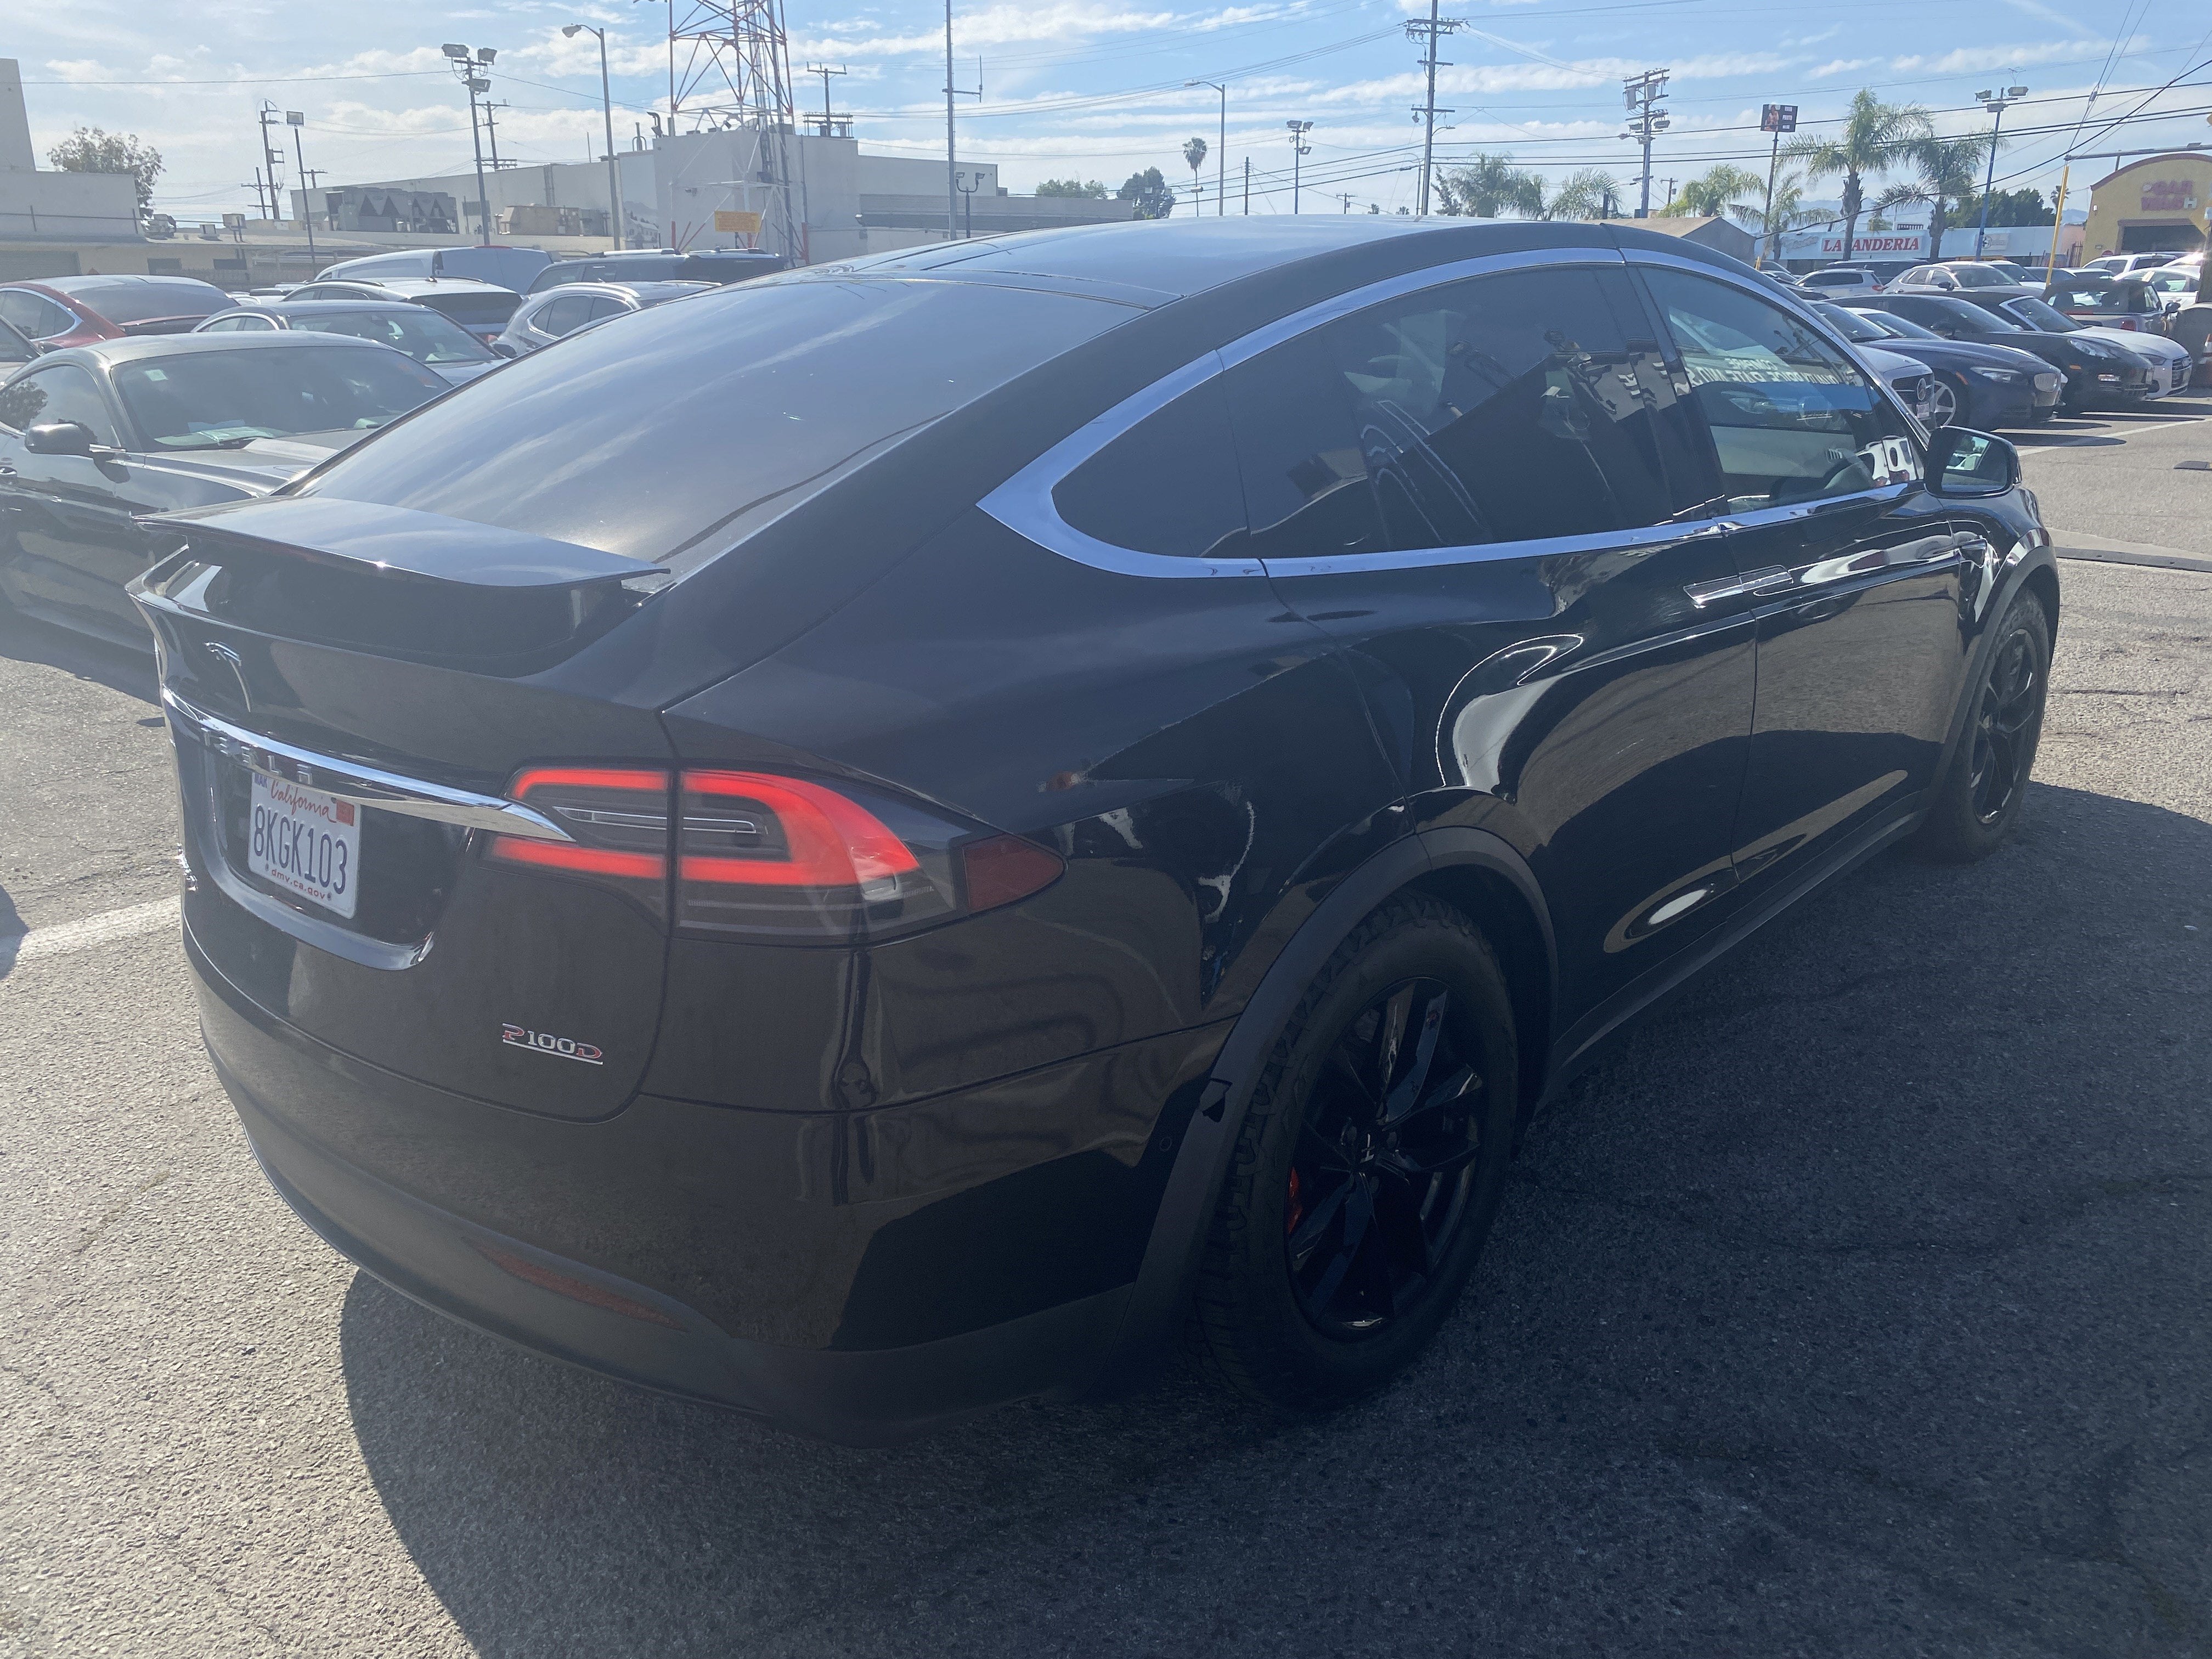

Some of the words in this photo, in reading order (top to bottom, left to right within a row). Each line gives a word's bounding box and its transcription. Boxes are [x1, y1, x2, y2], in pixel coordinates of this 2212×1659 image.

[1822, 238, 1920, 252] LAANDERIA
[271, 780, 337, 823] California
[253, 804, 347, 895] 8KGK103
[271, 868, 325, 899] dmv.ca.gov
[502, 1023, 602, 1059] P100D
